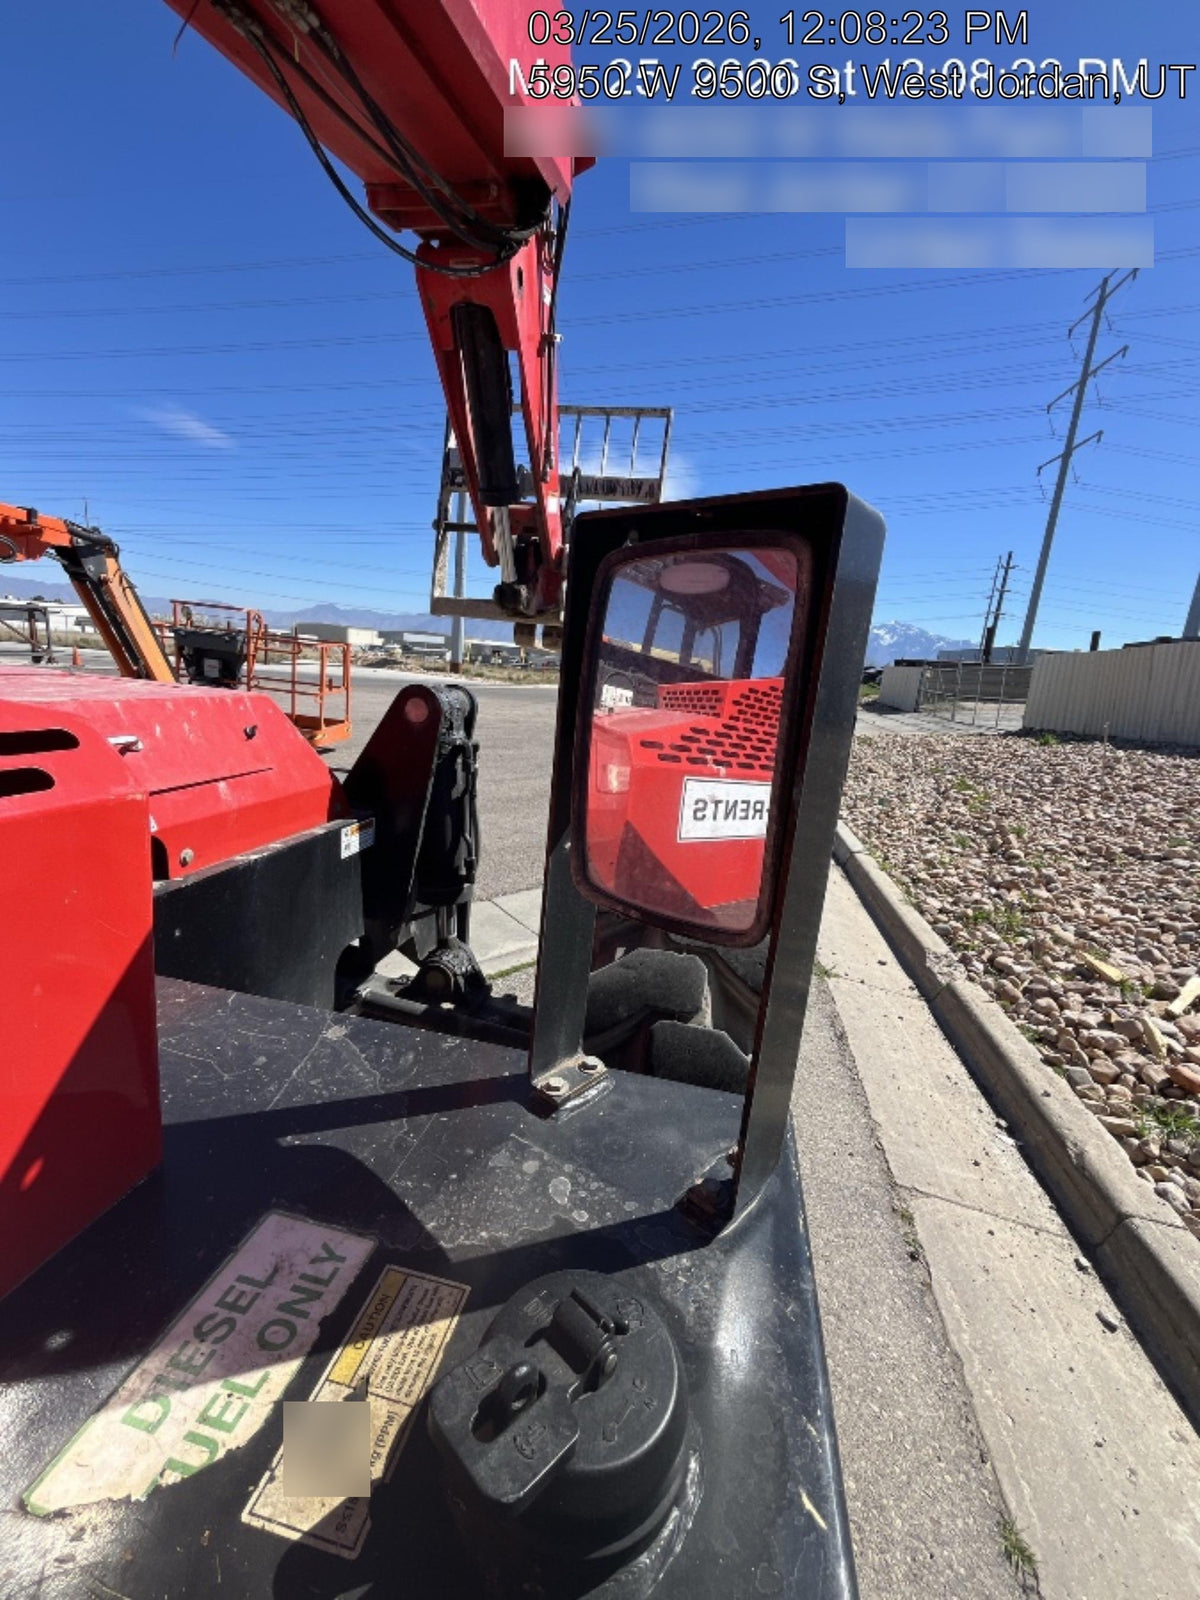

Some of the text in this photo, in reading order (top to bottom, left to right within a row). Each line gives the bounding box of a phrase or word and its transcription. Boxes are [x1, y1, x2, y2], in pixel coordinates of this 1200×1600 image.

[121, 1262, 280, 1435] DIESEL
[141, 1242, 347, 1498] UEL ONLY
[353, 1294, 390, 1350] CAUTION
